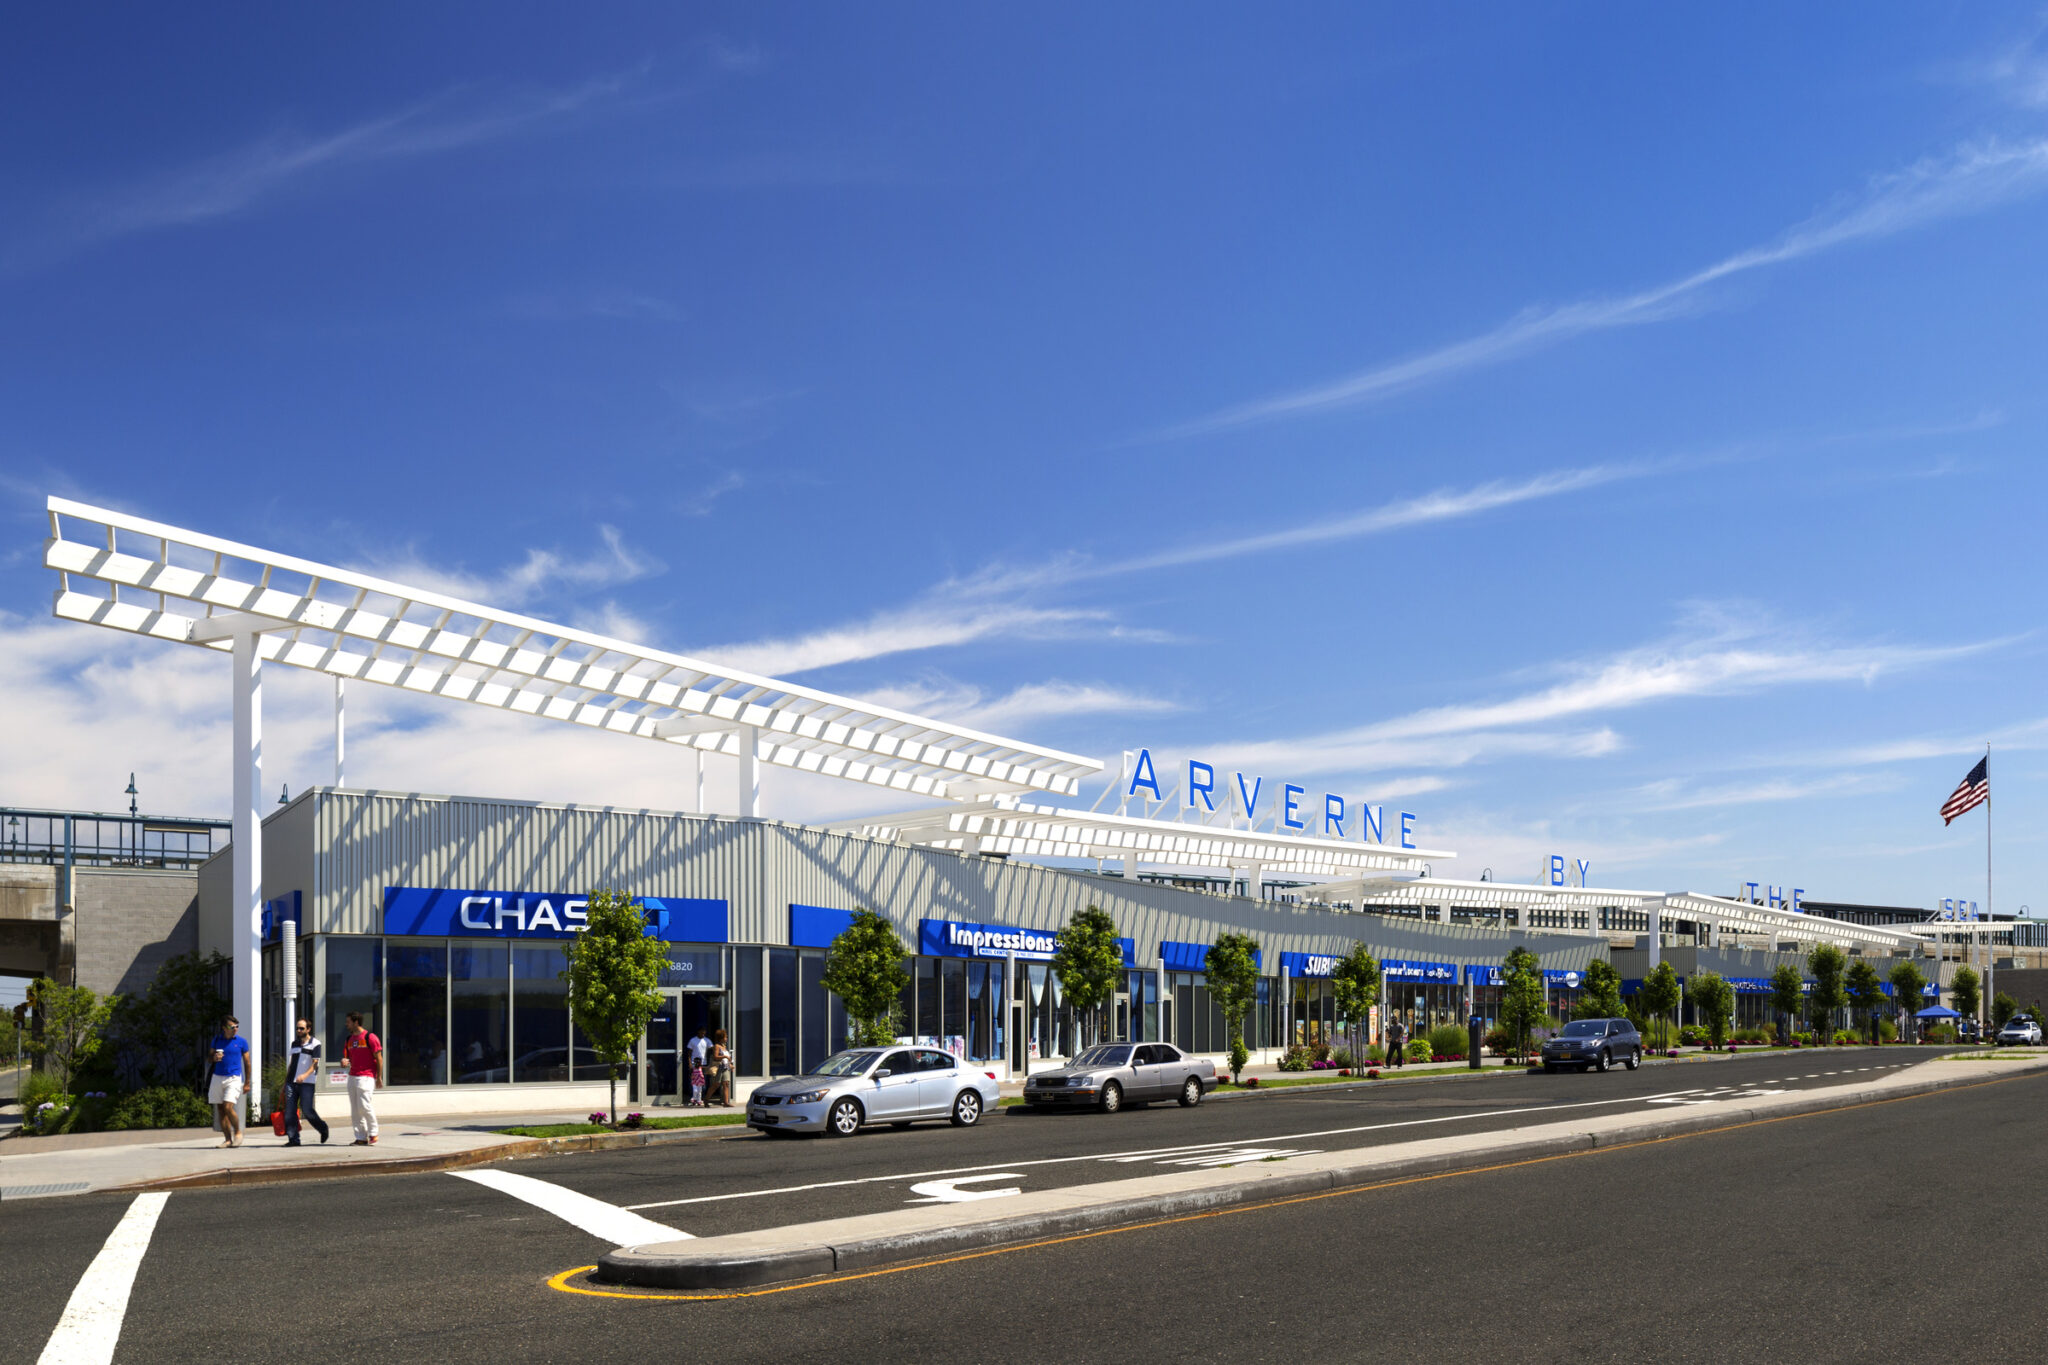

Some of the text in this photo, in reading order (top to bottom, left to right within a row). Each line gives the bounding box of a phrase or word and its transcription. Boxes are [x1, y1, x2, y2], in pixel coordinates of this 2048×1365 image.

[1128, 748, 1980, 922] ARVERNE BY THE SEA
[460, 896, 624, 934] CHAS
[949, 923, 1054, 956] Impressions
[670, 961, 693, 971] 6820
